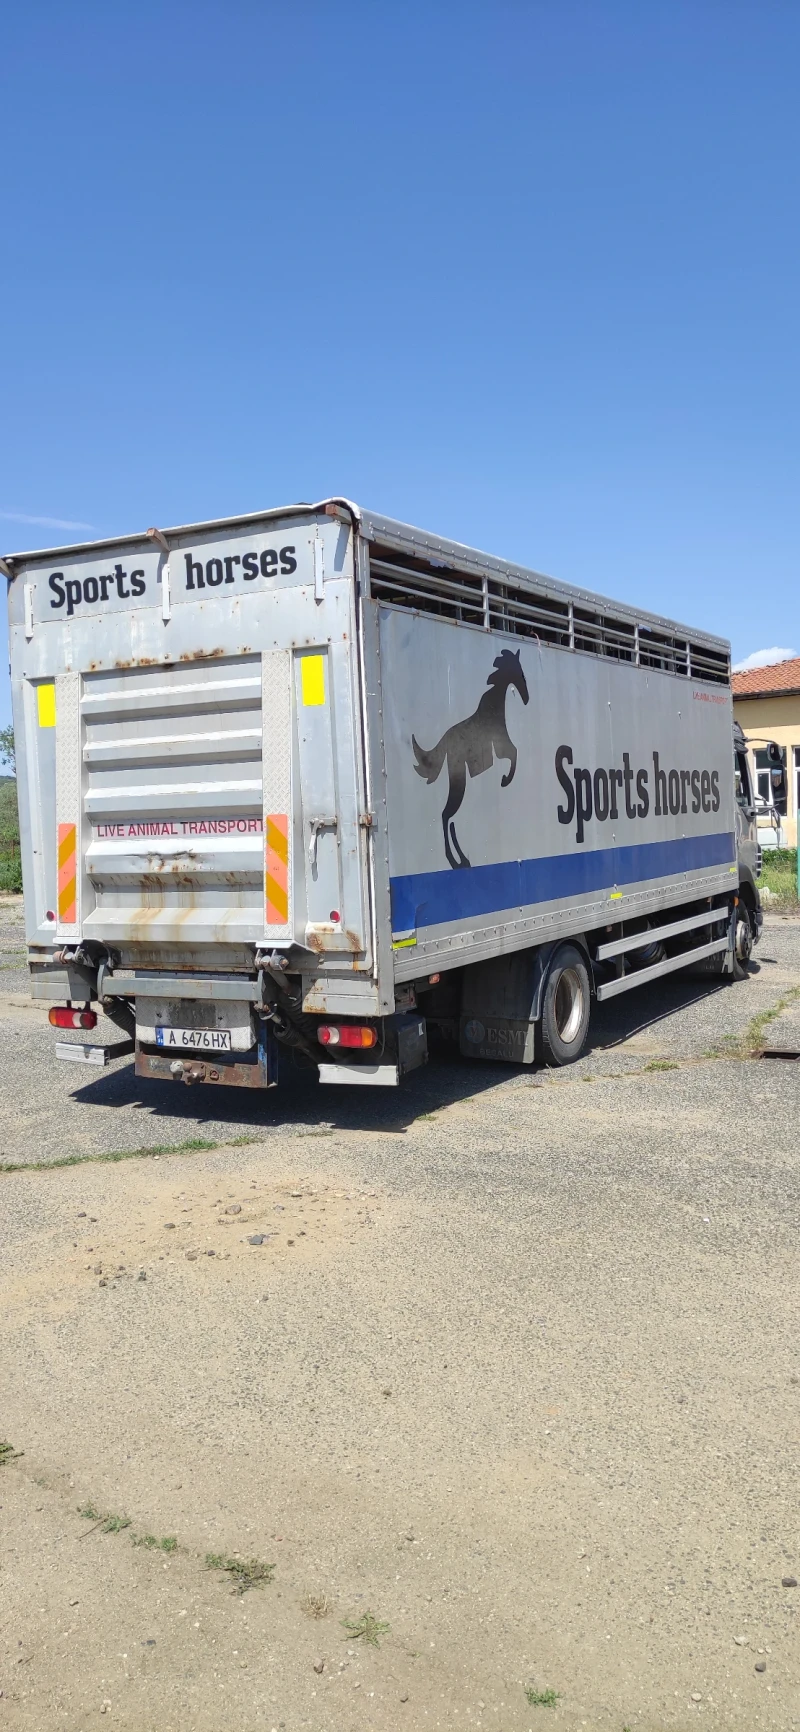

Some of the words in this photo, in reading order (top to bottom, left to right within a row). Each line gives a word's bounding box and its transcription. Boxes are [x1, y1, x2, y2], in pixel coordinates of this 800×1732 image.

[49, 564, 146, 615] Sports
[184, 546, 297, 590] horses
[97, 824, 125, 838] LIVE
[128, 822, 178, 836] ANIMAL
[180, 819, 263, 835] TRANSPORT
[555, 745, 649, 843] Sports
[652, 751, 720, 816] horses
